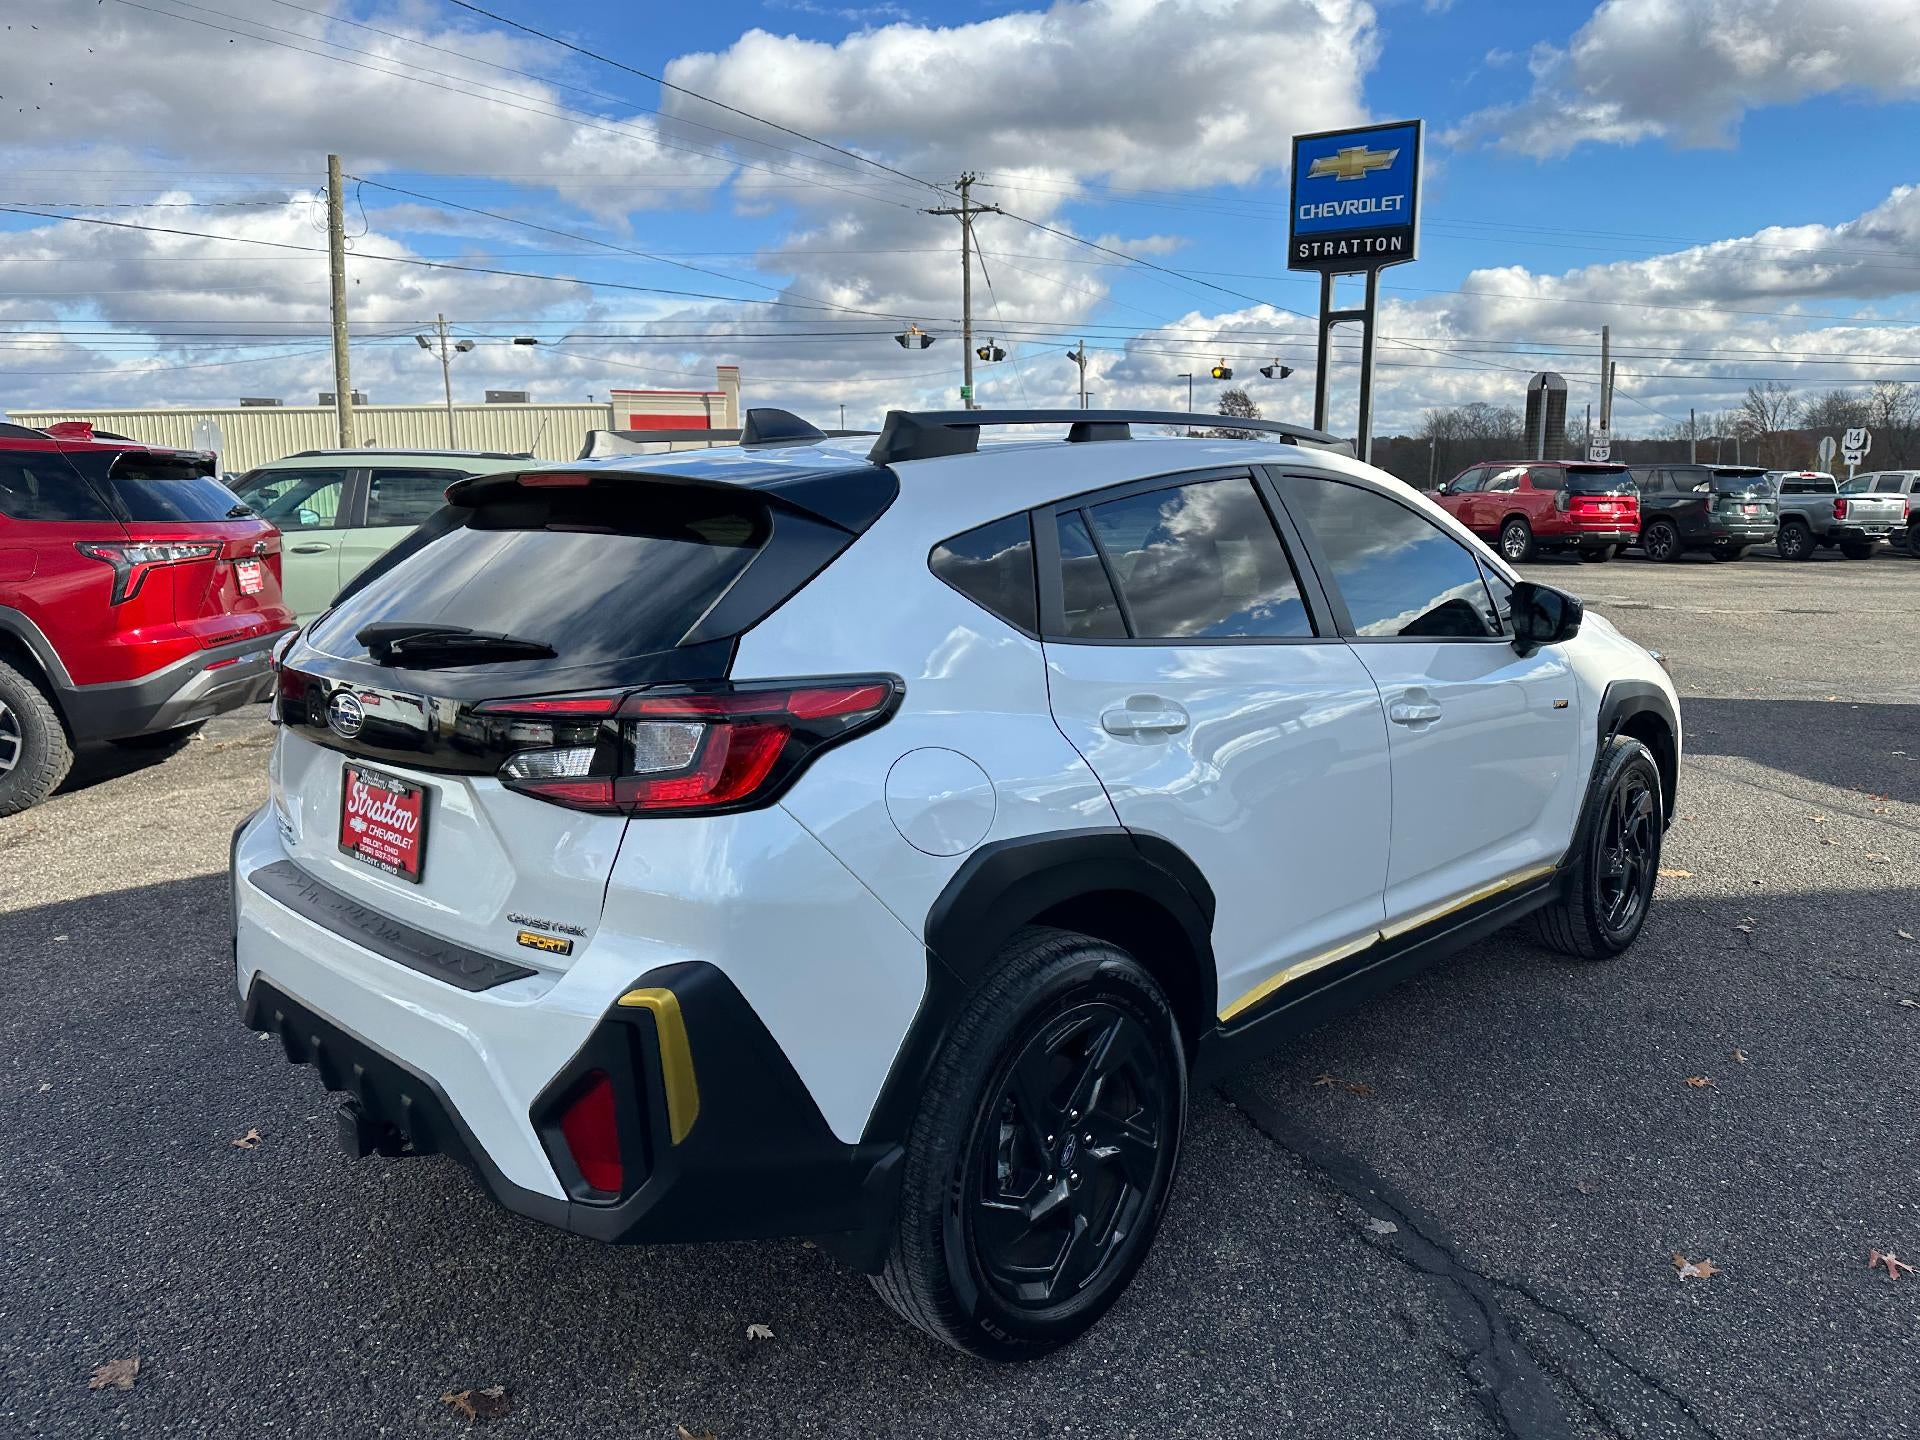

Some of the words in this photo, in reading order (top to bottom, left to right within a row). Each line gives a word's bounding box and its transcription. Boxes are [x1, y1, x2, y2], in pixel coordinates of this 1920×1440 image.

[1299, 195, 1405, 220] CHEVROLET
[1299, 236, 1402, 258] STRATTON
[1849, 431, 1861, 444] 14
[1592, 449, 1608, 458] 165
[347, 781, 418, 834] Stratton
[368, 824, 414, 850] CHEVROLET
[383, 844, 399, 856] OHIO
[381, 862, 398, 875] OHIO
[519, 932, 565, 952] SPORT
